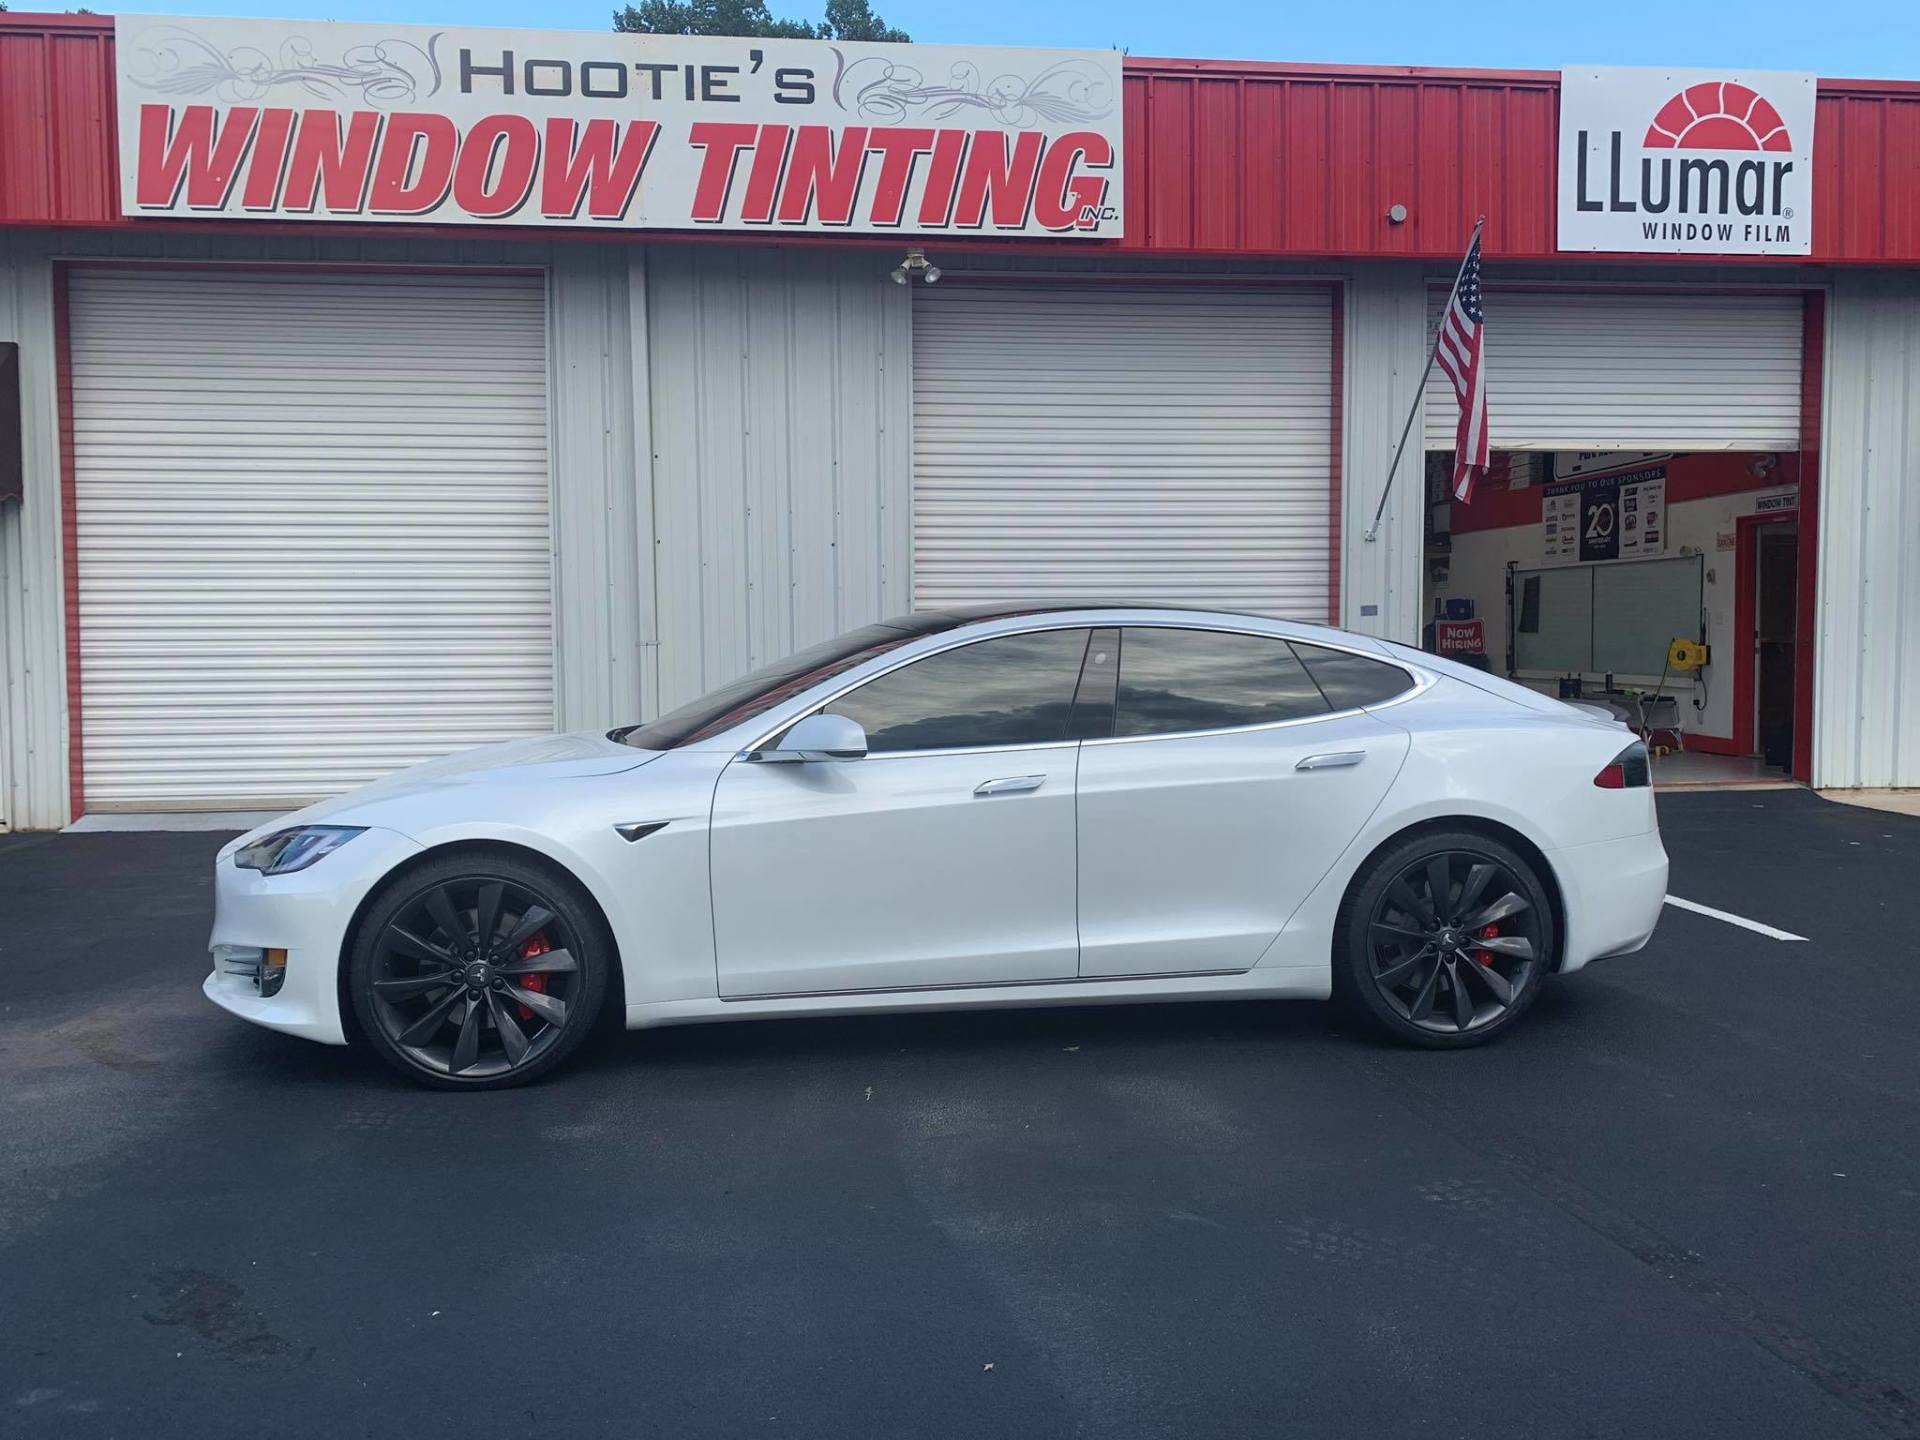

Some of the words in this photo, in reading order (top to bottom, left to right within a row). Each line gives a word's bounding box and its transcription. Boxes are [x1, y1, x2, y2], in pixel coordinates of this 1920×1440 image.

[460, 49, 815, 105] HOOTIE'S
[137, 104, 661, 225] WINDOW
[688, 122, 1115, 236] TINTING
[1577, 130, 1793, 216] LLumar
[1080, 207, 1119, 220] INC.
[1643, 222, 1733, 242] WINDOW
[1744, 224, 1791, 242] FILM
[1569, 483, 1584, 492] YOU
[1588, 480, 1598, 488] TO
[1600, 477, 1616, 487] OUR
[1617, 468, 1661, 482] SPONSORS
[1585, 503, 1614, 538] 20
[1441, 638, 1482, 649] HIRING
[1447, 627, 1475, 638] NOW
